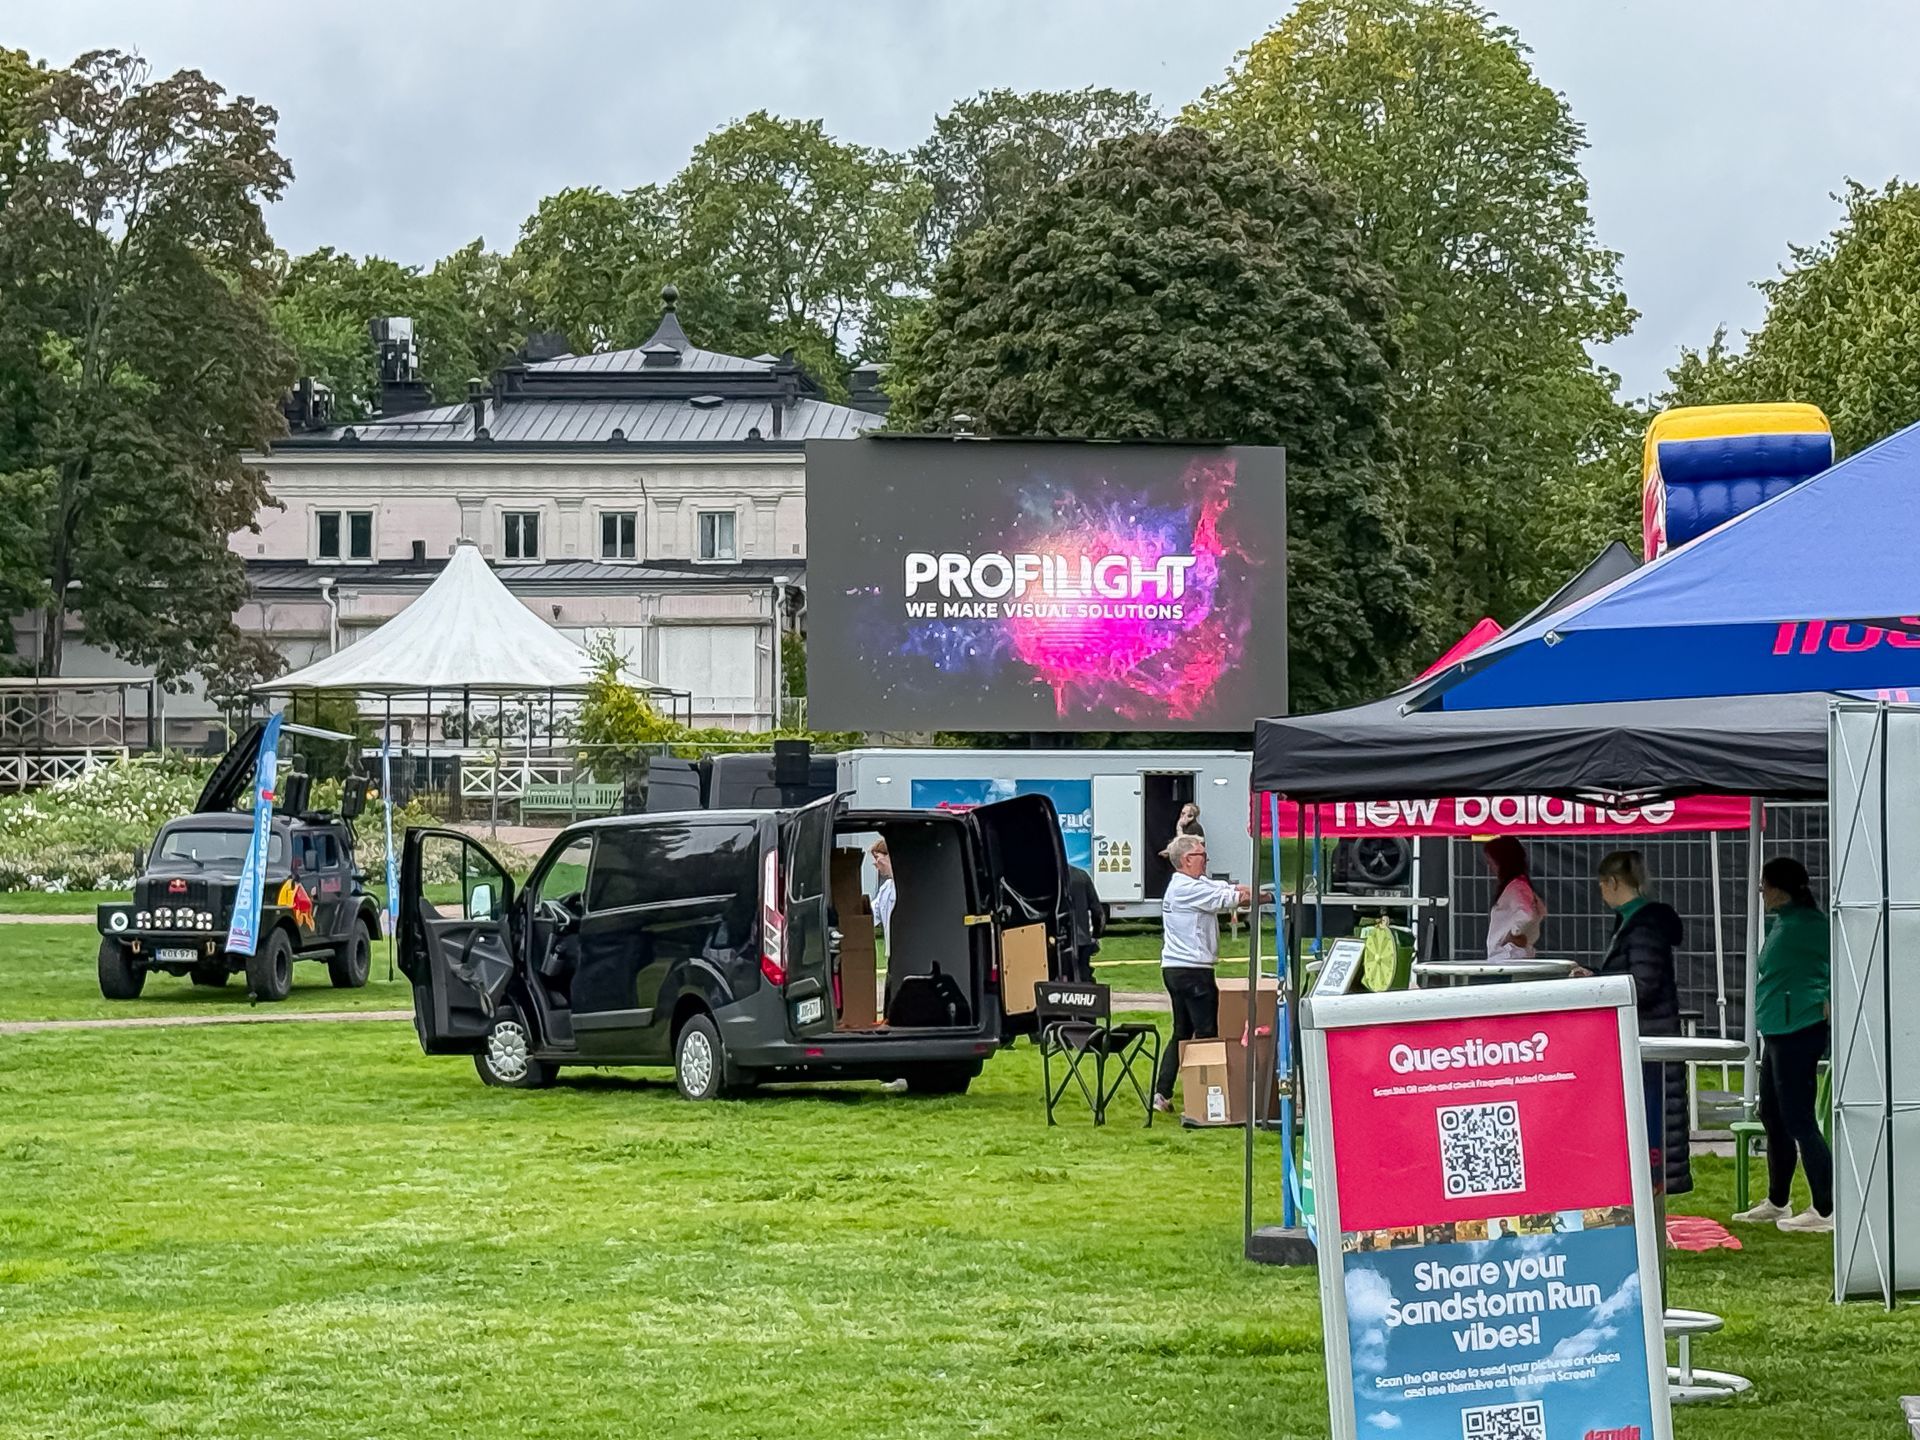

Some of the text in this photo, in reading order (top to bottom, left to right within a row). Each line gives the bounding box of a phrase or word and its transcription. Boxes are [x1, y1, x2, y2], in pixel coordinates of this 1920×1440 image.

[905, 552, 1197, 599] PROFILIGHT
[905, 602, 1184, 620] WE MAKE VISUAL SOLUTIONS
[1333, 796, 1441, 828] new
[1061, 992, 1096, 1007] KARHU
[1389, 1032, 1548, 1073] Questions?
[1414, 1255, 1567, 1292] Share your
[1385, 1281, 1602, 1328] Sandstorm Run
[1453, 1316, 1541, 1353] vibes!
[1375, 1352, 1621, 1388] Scan the QR code to send your pictures or videos
[1403, 1385, 1427, 1398] and
[1427, 1386, 1447, 1396] see
[1447, 1382, 1473, 1394] them
[1494, 1378, 1509, 1389] on
[1509, 1375, 1527, 1387] the
[1526, 1372, 1557, 1385] Event
[1556, 1367, 1596, 1382] Screen!
